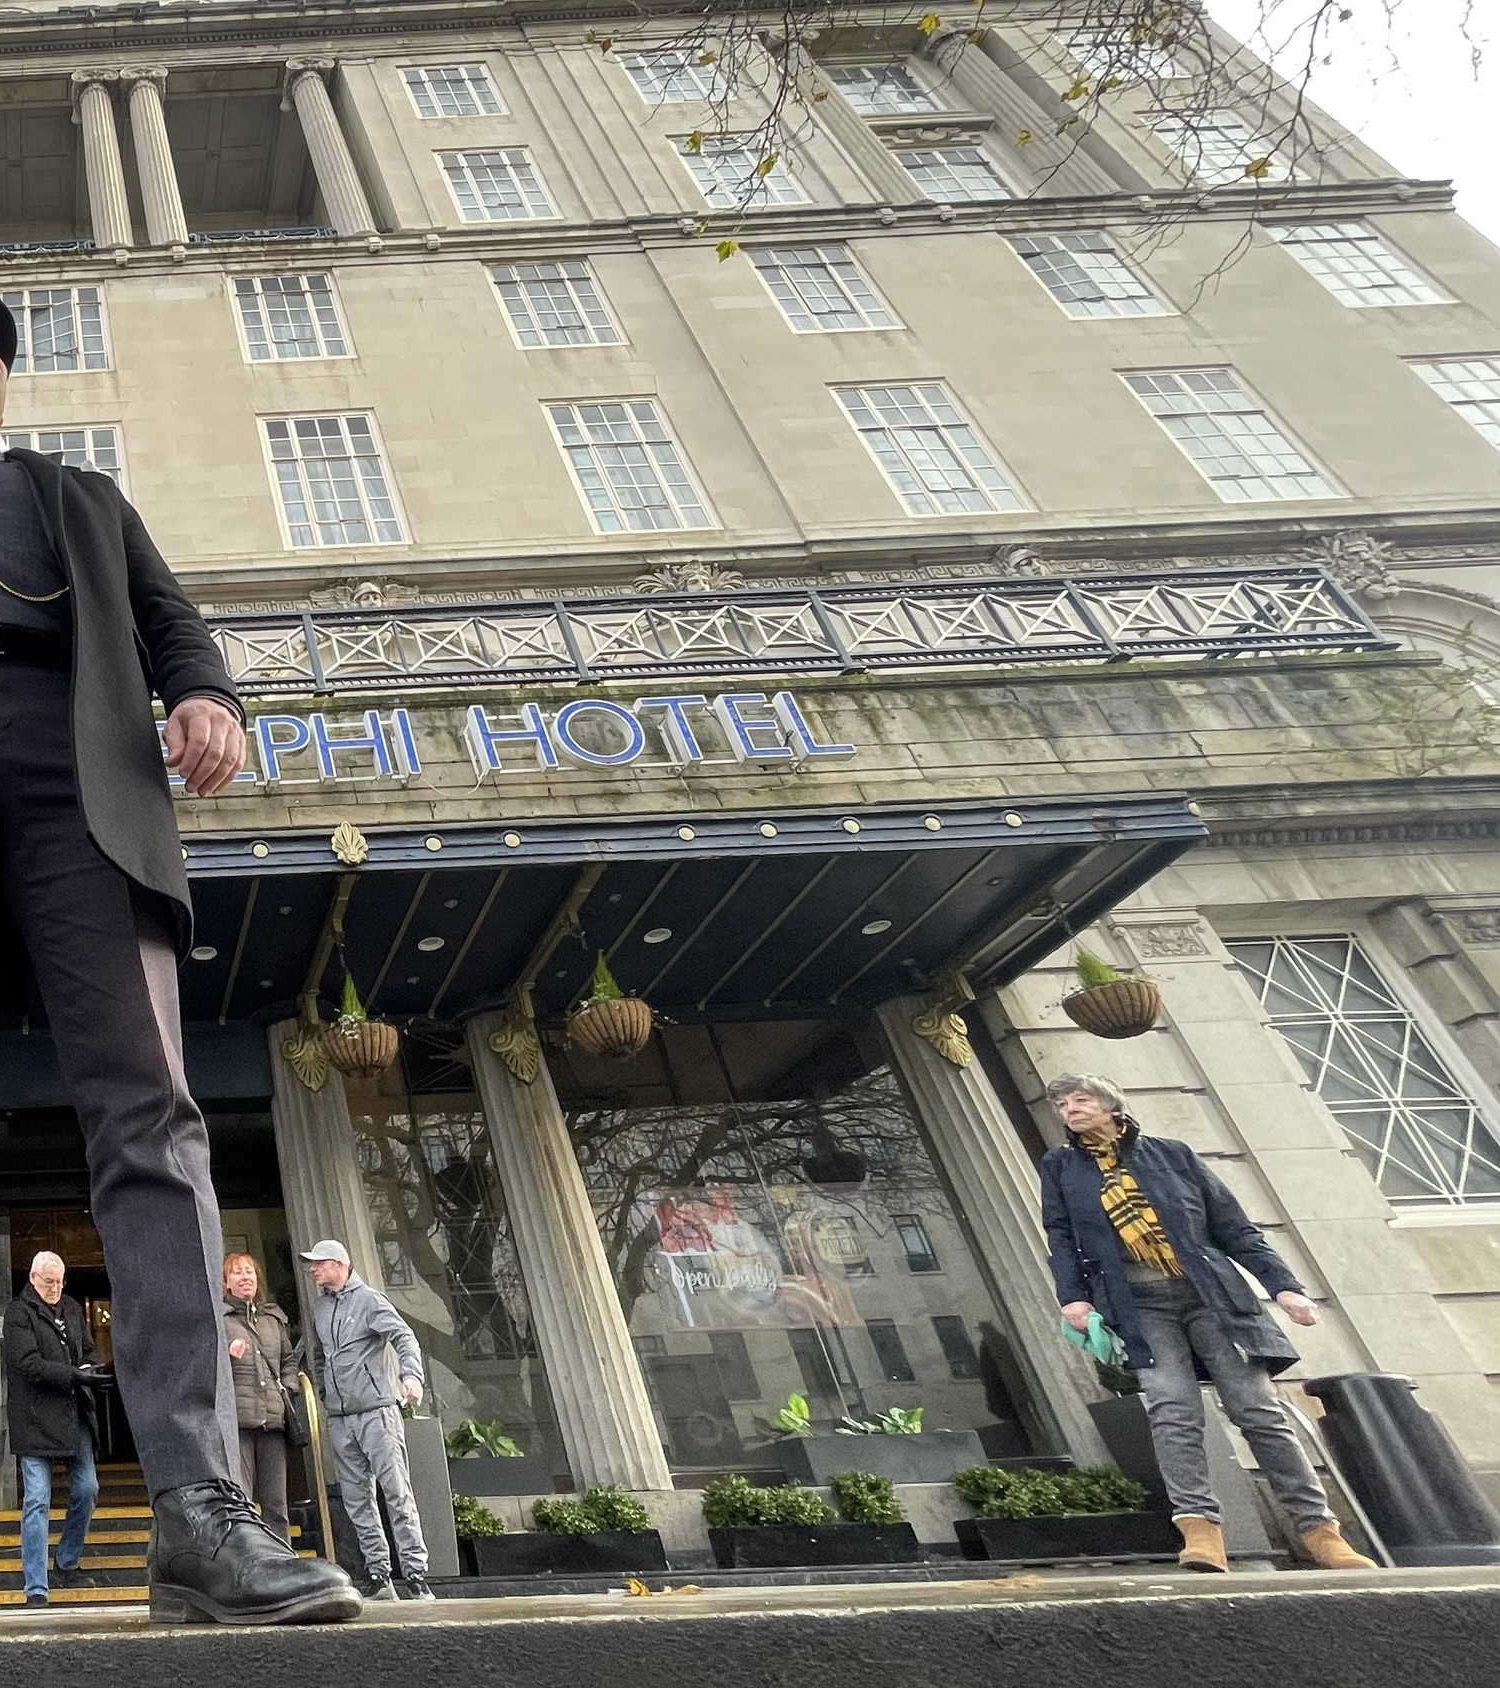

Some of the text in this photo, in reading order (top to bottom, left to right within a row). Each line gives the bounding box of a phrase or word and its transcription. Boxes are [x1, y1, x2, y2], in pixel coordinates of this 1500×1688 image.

[466, 690, 856, 775] HOTEL
[673, 1262, 777, 1294] Open Daily
